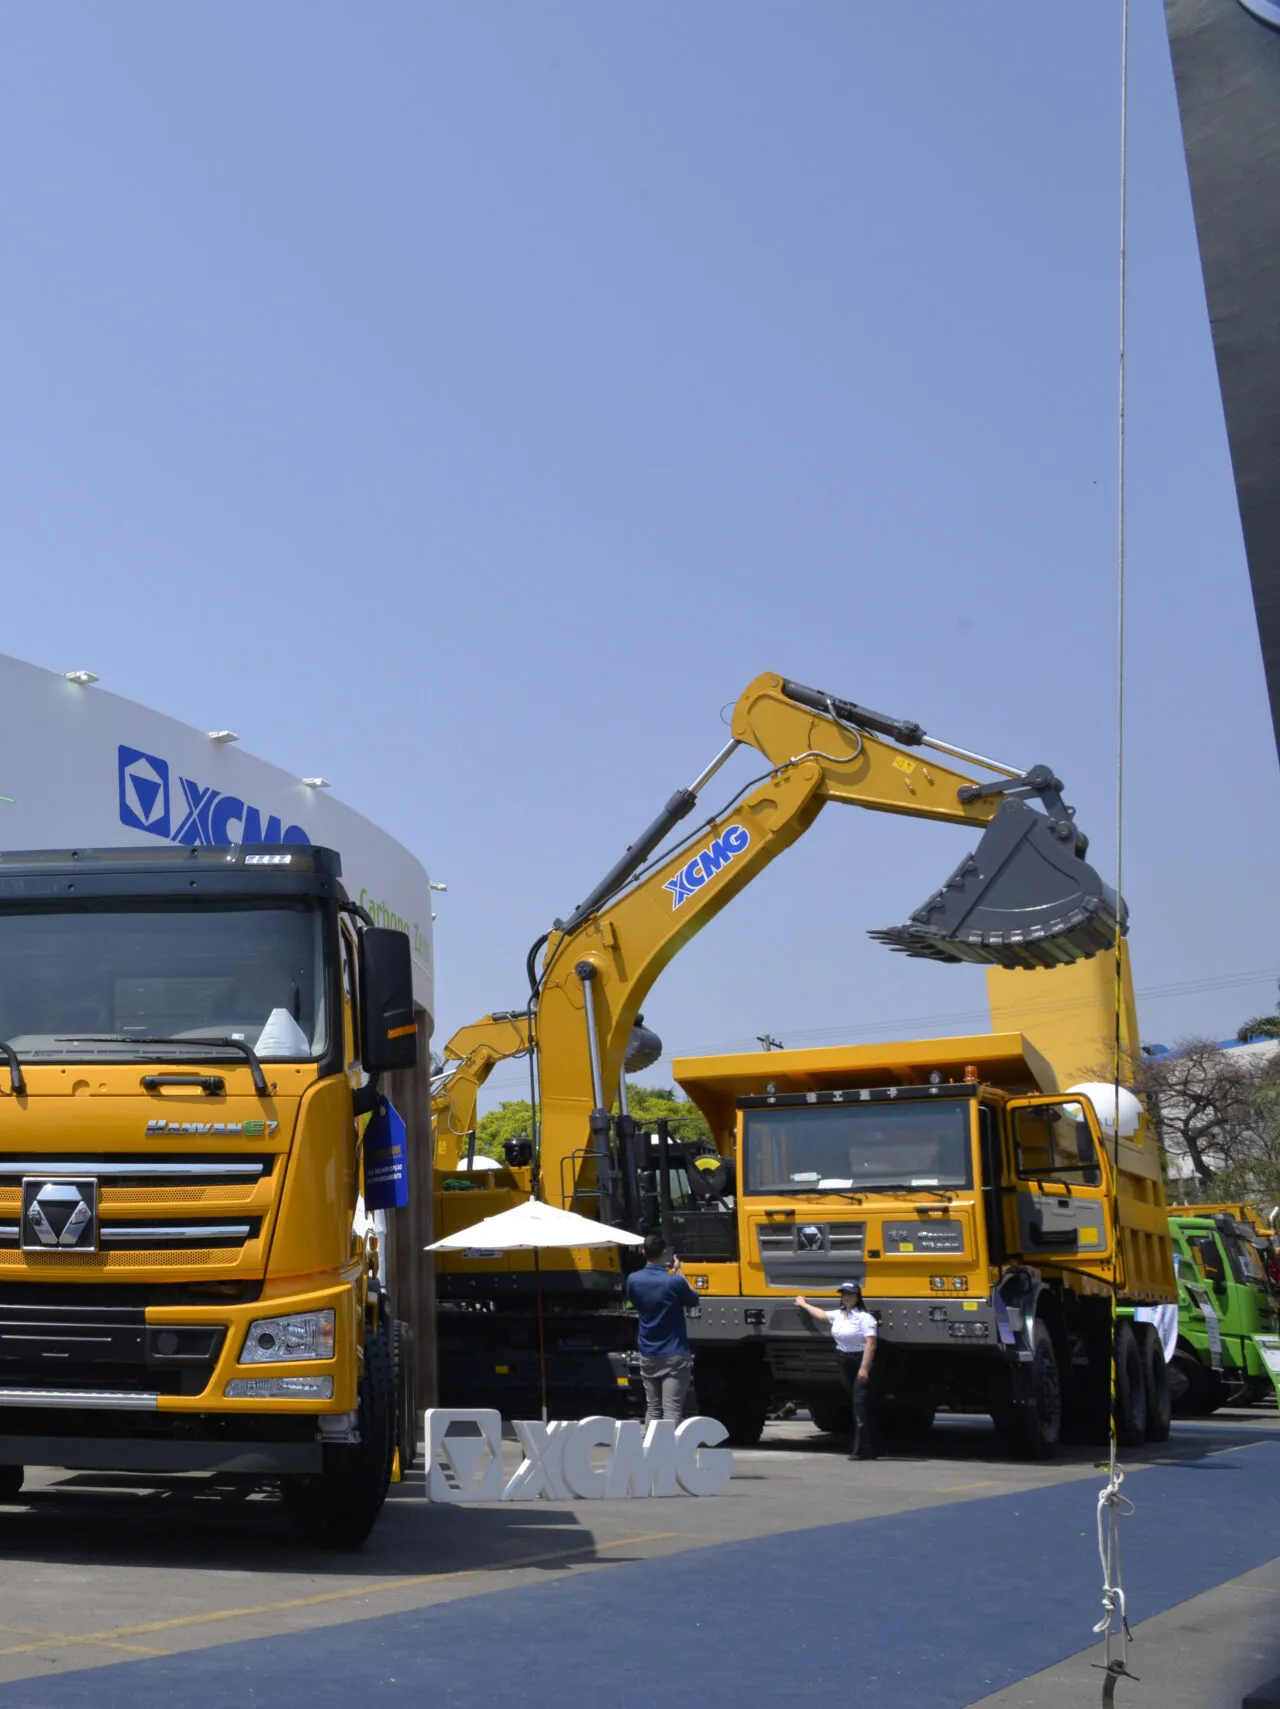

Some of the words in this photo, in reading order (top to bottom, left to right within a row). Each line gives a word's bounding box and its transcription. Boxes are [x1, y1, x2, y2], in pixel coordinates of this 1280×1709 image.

[171, 776, 312, 846] XCM
[661, 823, 751, 911] XCMG
[502, 1416, 733, 1500] XCMG
